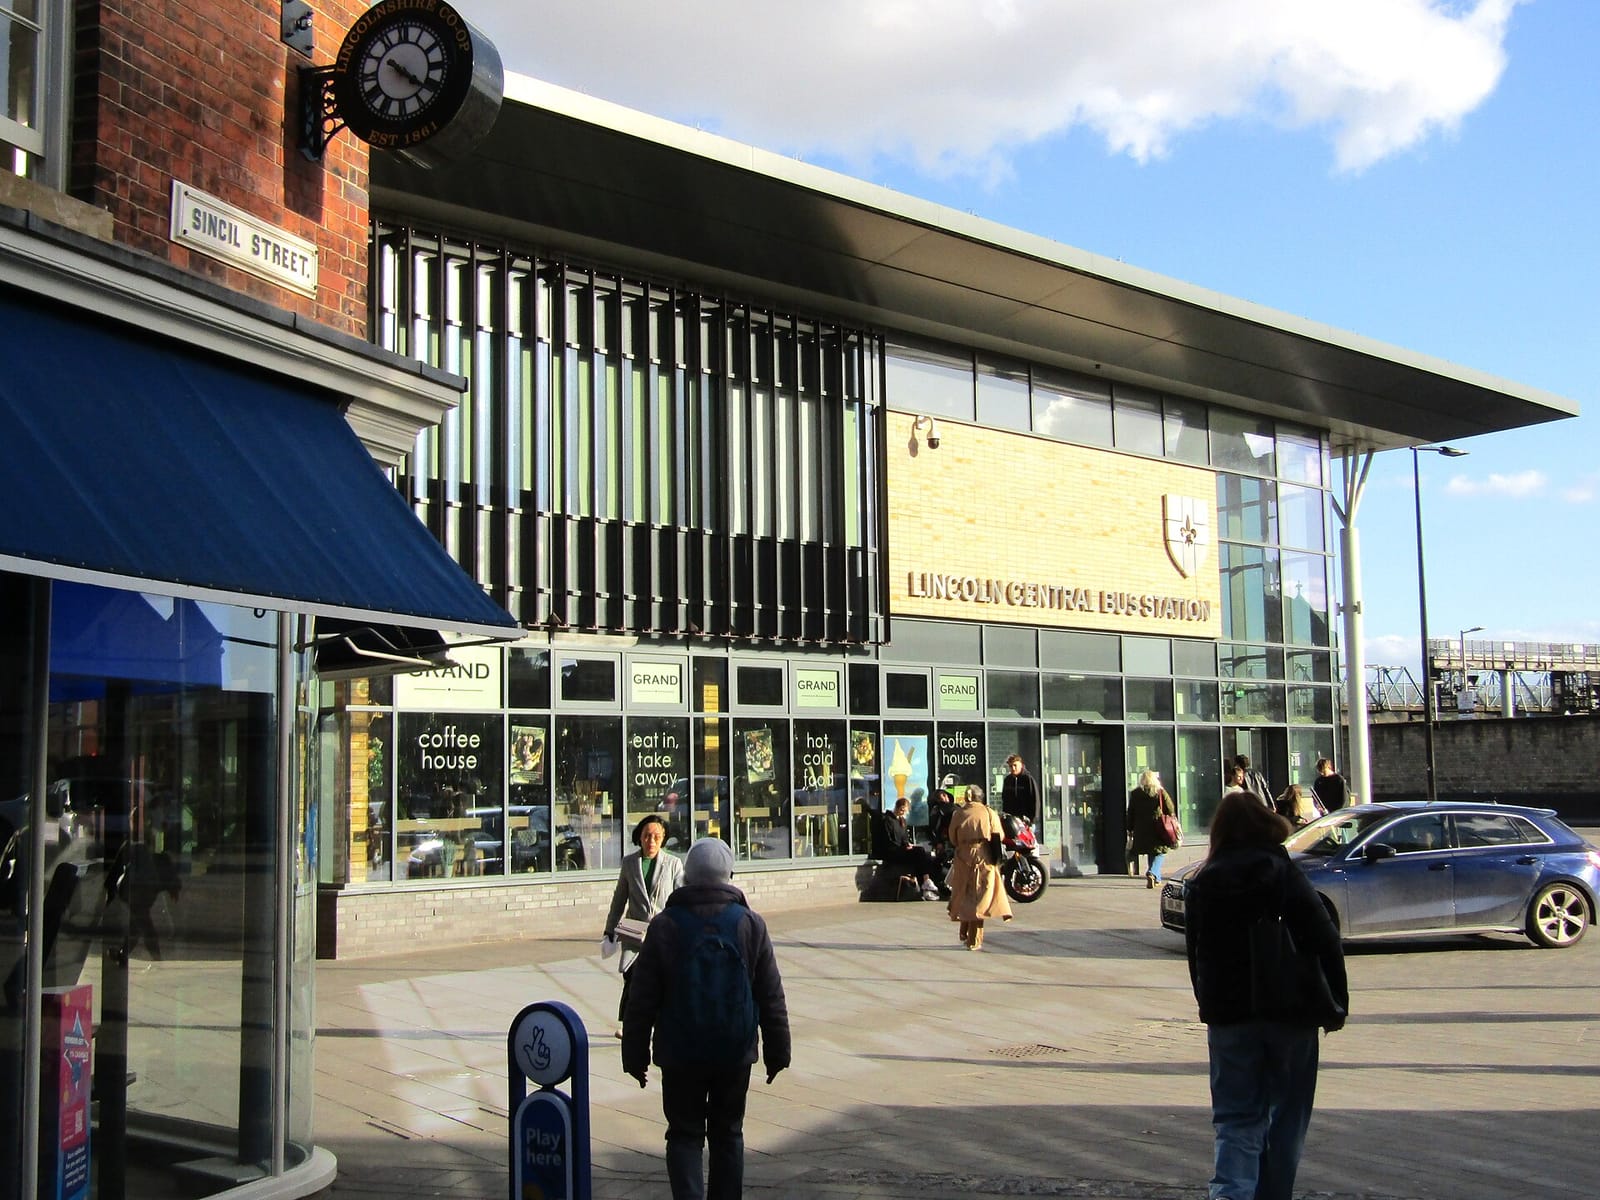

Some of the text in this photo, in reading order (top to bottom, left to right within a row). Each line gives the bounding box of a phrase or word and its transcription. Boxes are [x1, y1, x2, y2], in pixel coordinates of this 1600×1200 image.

[440, 6, 471, 52] CO-OP
[368, 121, 437, 146] EST 1861
[191, 207, 311, 279] SINCIL STREET.
[908, 571, 1211, 622] LINCOLN CENTRAL BUS STATION
[632, 673, 679, 687] GRAND
[797, 679, 837, 692] GRAND
[939, 683, 977, 696] GRAND
[418, 725, 481, 749] coffee
[633, 732, 679, 749] eat in,
[806, 731, 831, 749] hot,
[940, 731, 978, 749] coffee
[421, 749, 478, 770] house
[637, 752, 672, 768] take
[803, 751, 833, 766] cold
[942, 750, 977, 765] house
[635, 772, 678, 788] away
[803, 768, 834, 787] food
[526, 1127, 561, 1150] Play
[526, 1147, 562, 1166] here
